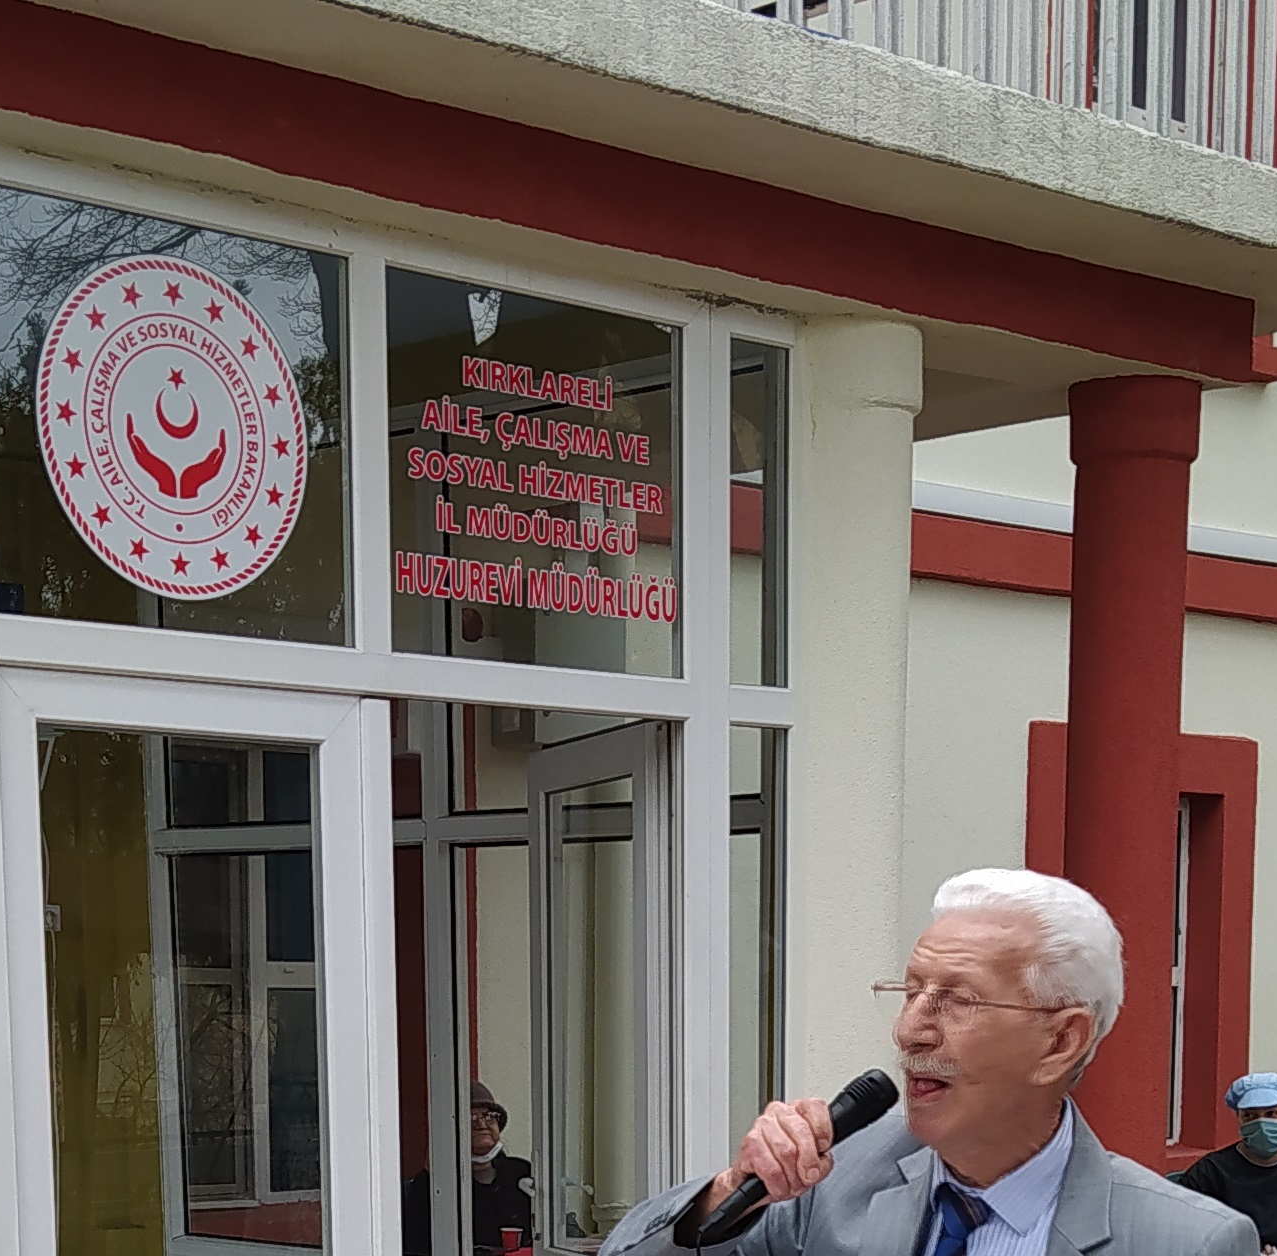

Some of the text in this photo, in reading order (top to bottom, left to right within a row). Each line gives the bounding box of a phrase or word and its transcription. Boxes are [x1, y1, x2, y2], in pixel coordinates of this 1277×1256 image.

[115, 330, 139, 354] VE
[136, 321, 198, 348] SOSYAL
[90, 350, 122, 434] ÇALIŞMA
[199, 336, 259, 436] HİZMETLER
[462, 356, 614, 412] KIRKLARELİ
[421, 395, 650, 466] AİLE, ÇALIŞMA VE
[122, 486, 146, 520] T.C.
[211, 440, 260, 528] BAKANLIĞI
[407, 448, 664, 514] SOSYAL HİZMETLER
[435, 495, 639, 557] İL MÜDÜRLÜĞÜ
[395, 551, 678, 623] HUZUREVİ MÜDÜRLÜĞÜ
